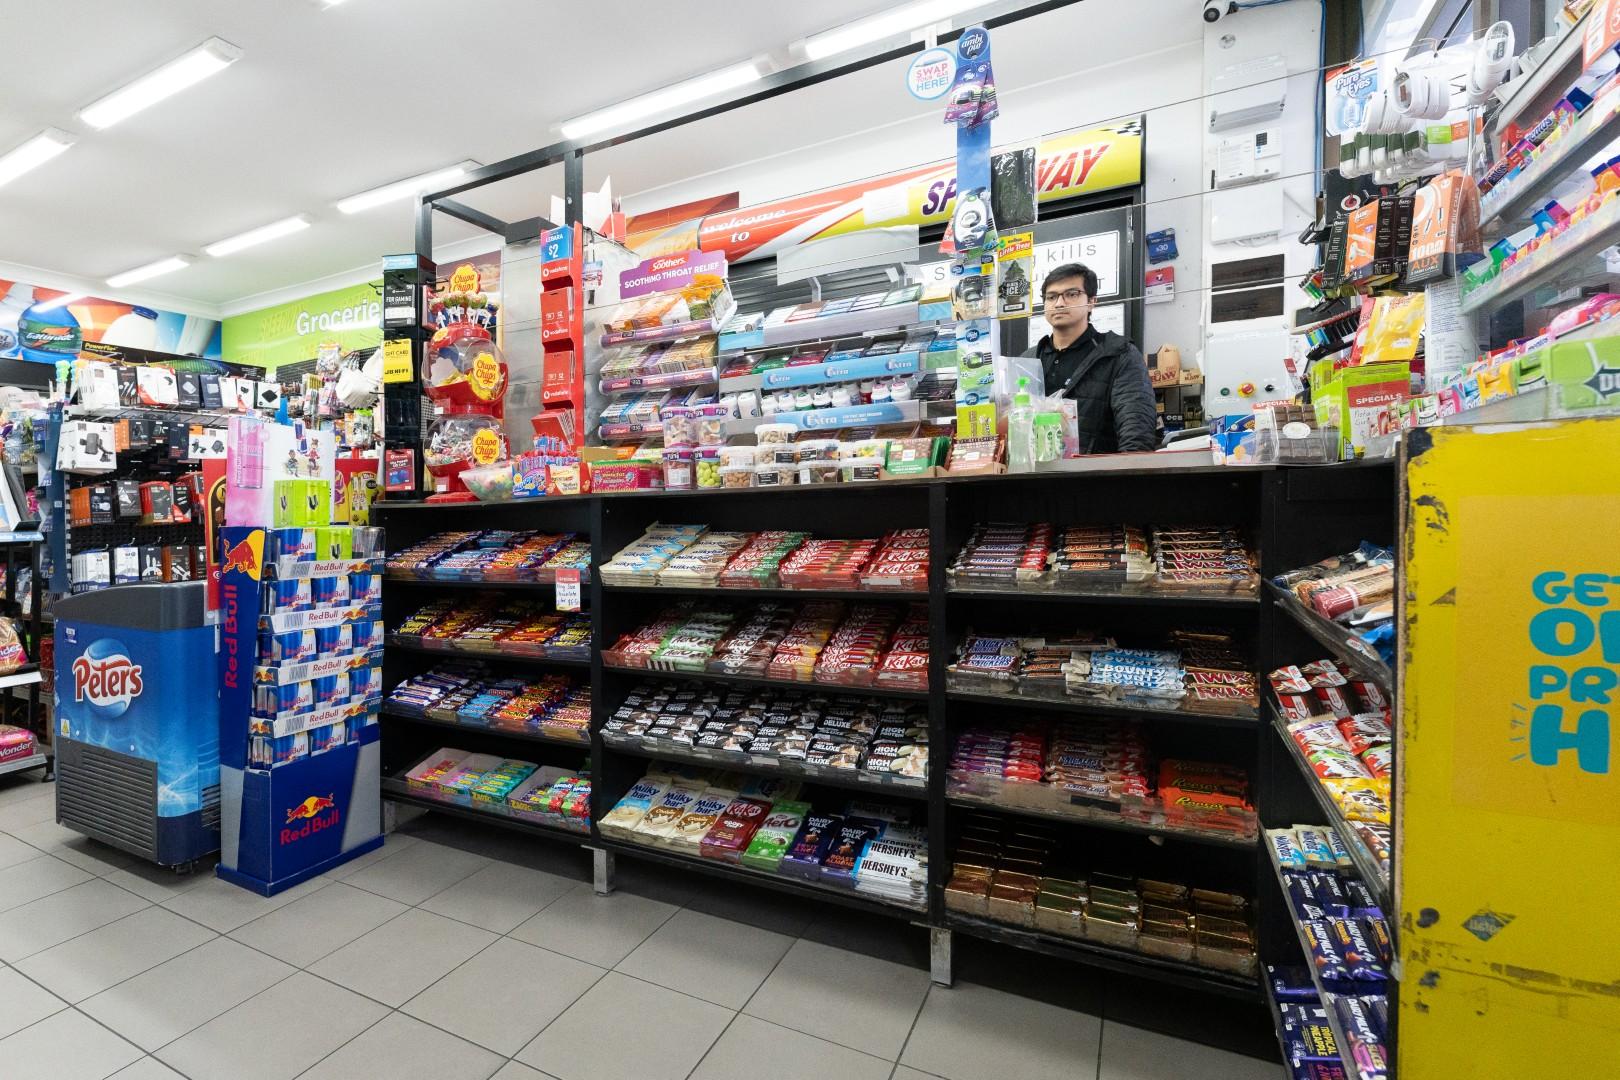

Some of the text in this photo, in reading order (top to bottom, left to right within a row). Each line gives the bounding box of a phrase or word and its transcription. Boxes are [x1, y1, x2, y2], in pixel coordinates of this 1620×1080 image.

[961, 33, 984, 49] ambi
[966, 42, 984, 56] pur
[916, 63, 948, 76] SWAP
[702, 208, 787, 234] welcome
[730, 230, 750, 244] to
[548, 244, 559, 259] $2
[999, 246, 1015, 257] Little
[1047, 243, 1097, 262] kills
[652, 257, 687, 271] Soothers
[1411, 255, 1440, 271] AUX
[453, 274, 475, 285] Chupa
[624, 262, 720, 289] SOOTHING THROAT RELIEF
[1006, 286, 1019, 295] ICE
[296, 298, 381, 336] Grocerie
[476, 360, 497, 371] Chupa
[888, 360, 912, 370] Extra
[475, 369, 497, 384] Chups
[827, 367, 849, 377] Extra
[1255, 400, 1294, 409] SPECIALS
[1355, 392, 1404, 406] SPECIALS
[806, 414, 837, 426] Extra
[476, 436, 497, 447] Chupa
[475, 446, 497, 460] Chups
[299, 542, 313, 550] Bull
[314, 563, 344, 571] Red Bull
[308, 610, 339, 620] Red Bull
[225, 584, 238, 688] Red Bull
[312, 661, 342, 672] Red Bull
[887, 655, 927, 669] KitKat
[1104, 663, 1166, 677] BOUNTY
[73, 658, 142, 701] Peters
[1190, 671, 1249, 684] TWIX
[1529, 665, 1620, 705] PR
[1194, 686, 1256, 700] TWIX
[309, 709, 339, 723] Red Bull
[823, 719, 852, 728] DELUXE
[812, 743, 841, 752] DELUXE
[867, 759, 891, 767] HIGH
[630, 791, 650, 799] bar
[632, 784, 660, 796] Milky
[663, 792, 694, 804] Milky
[663, 800, 683, 808] bar
[695, 799, 726, 811] Milky
[695, 806, 715, 815] bar
[728, 803, 762, 817] KitKat
[280, 809, 340, 846] Red Bull
[808, 817, 834, 825] DAIRY
[841, 827, 869, 836] DAIRY
[841, 832, 862, 840] MILK
[871, 842, 916, 860] HERSHEY'S
[861, 859, 908, 877] HERSHEY'S
[1309, 1024, 1328, 1057] PINEAPPLE
[1319, 1025, 1338, 1055] TROPICAL
